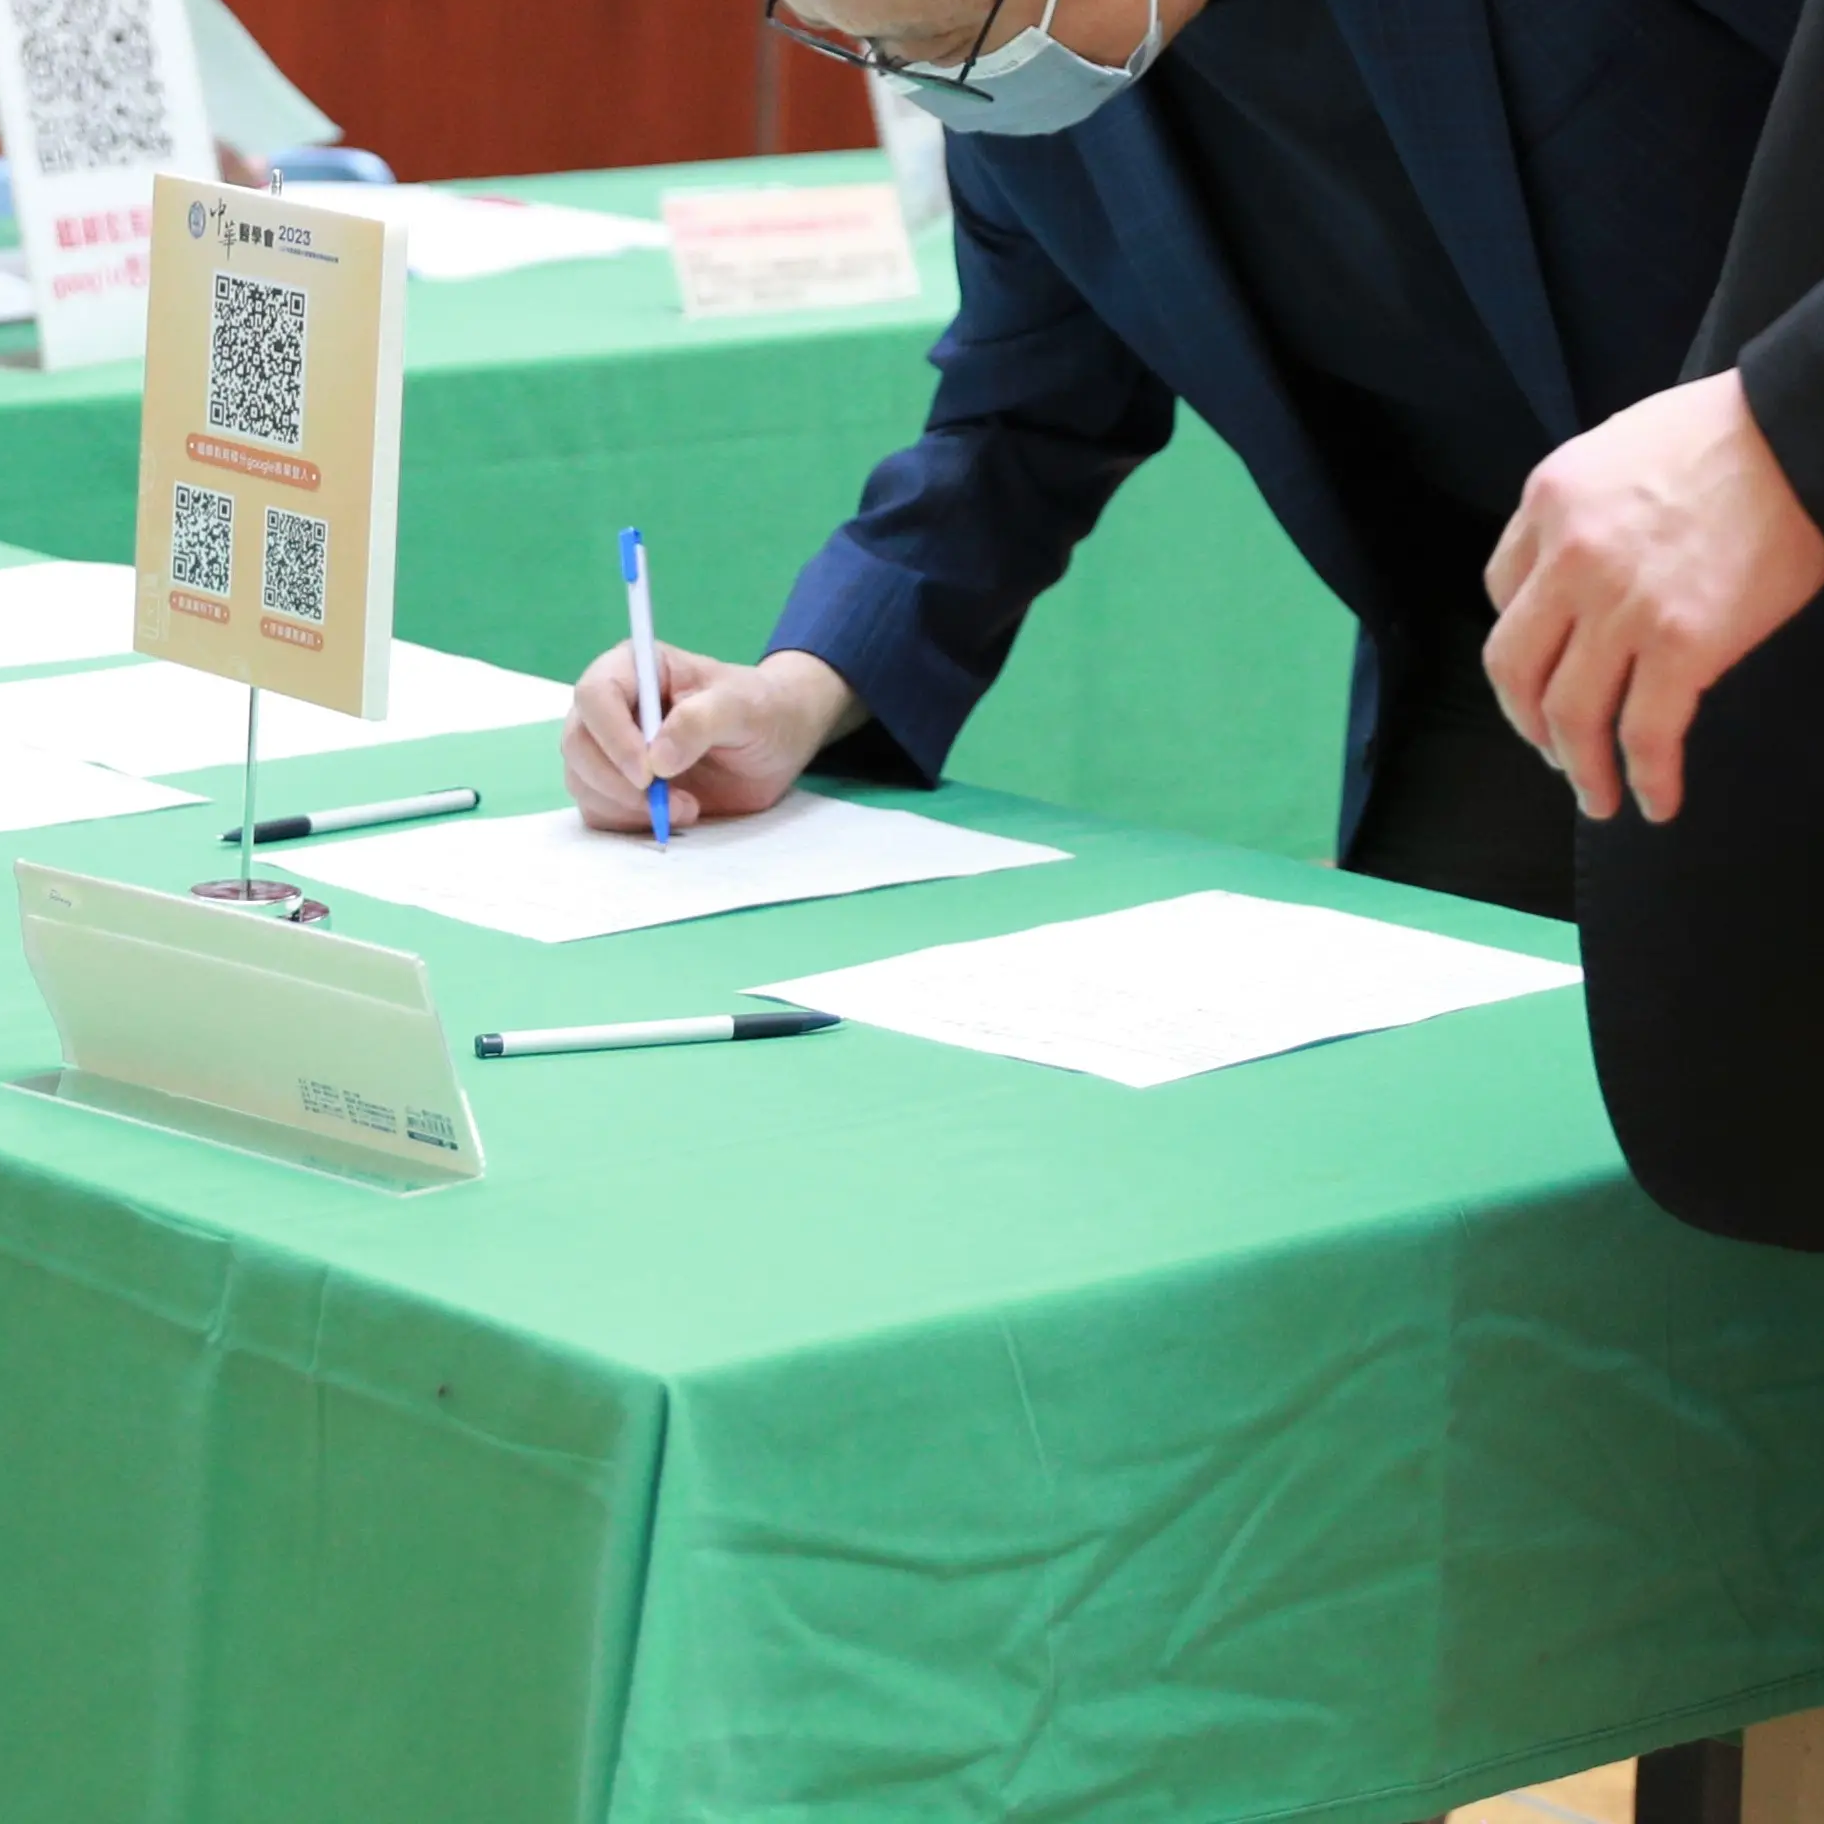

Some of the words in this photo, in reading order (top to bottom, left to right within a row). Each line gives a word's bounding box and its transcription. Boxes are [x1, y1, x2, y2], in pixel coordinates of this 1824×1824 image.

[209, 197, 275, 262] 中華醫學會
[278, 225, 312, 247] 2023
